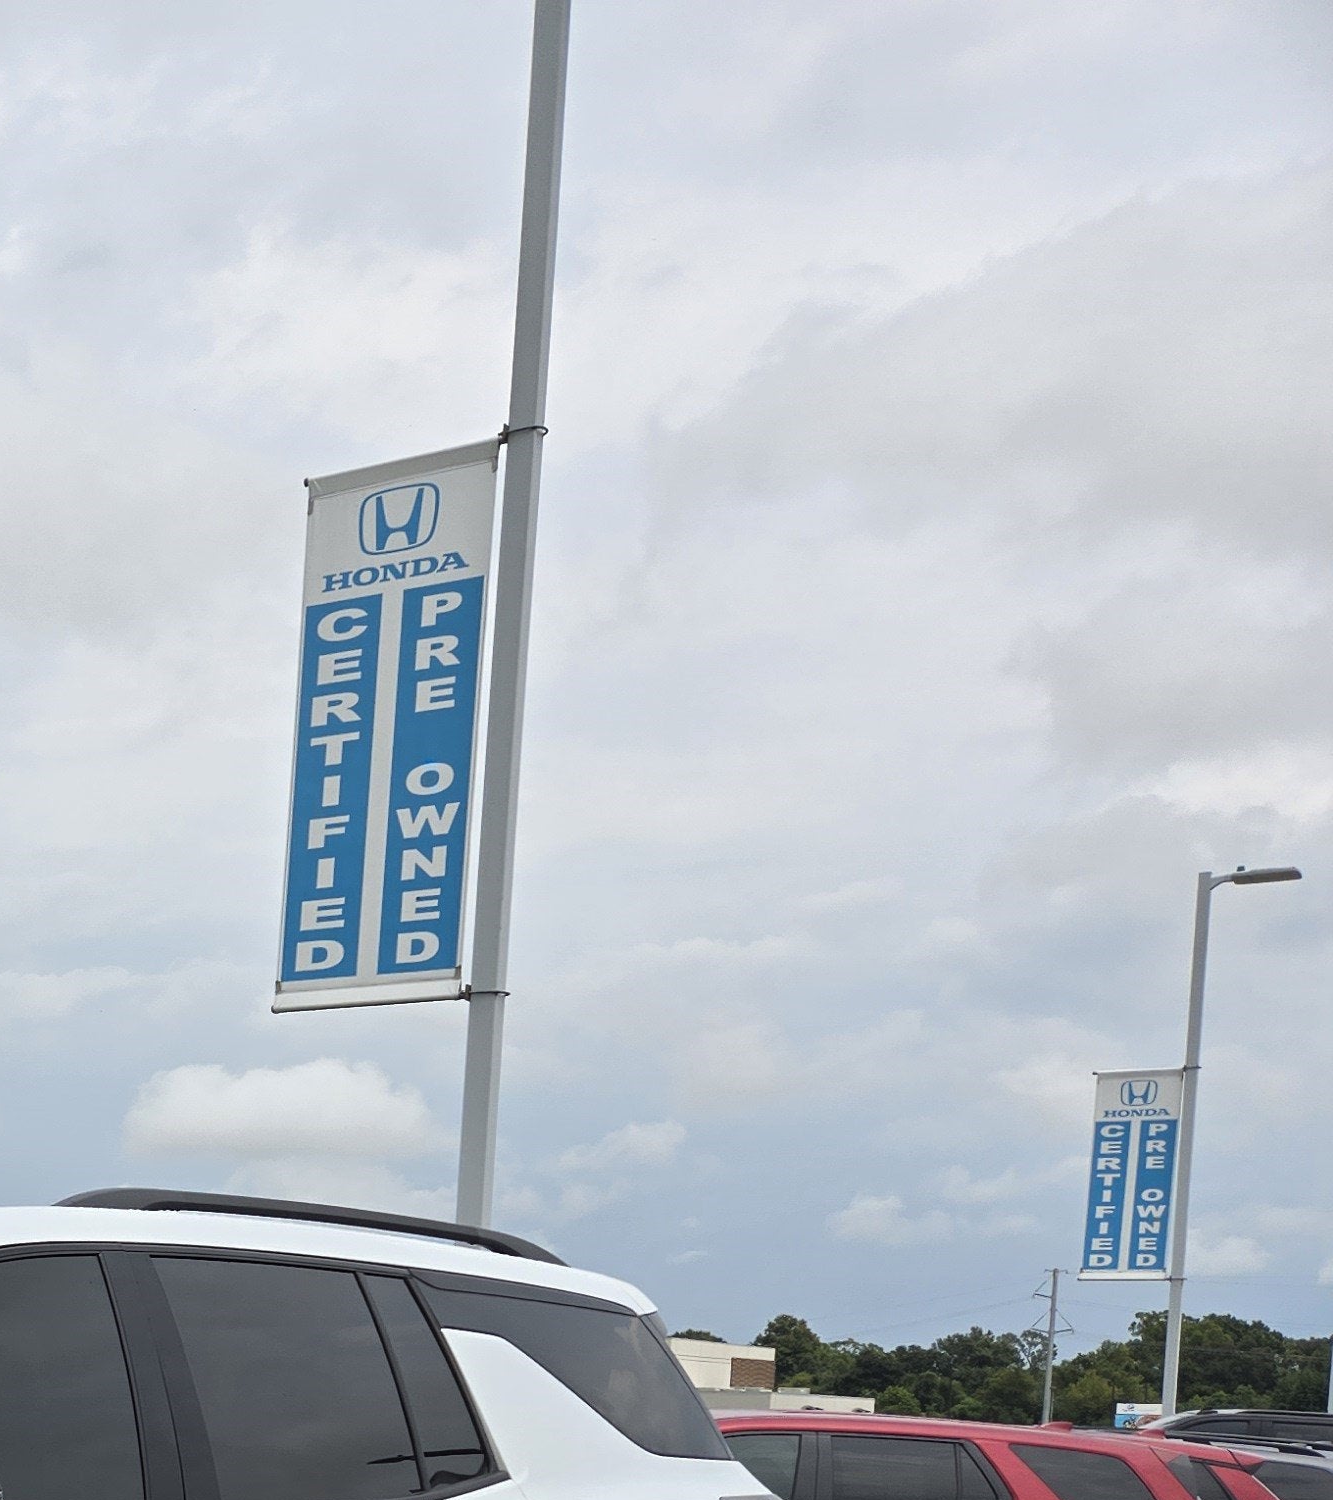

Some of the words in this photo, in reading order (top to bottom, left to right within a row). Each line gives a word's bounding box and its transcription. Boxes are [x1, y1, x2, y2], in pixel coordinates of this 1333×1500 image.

[321, 551, 470, 592] HONDA
[413, 590, 464, 713] PRE
[294, 607, 369, 973] CERTIFIED
[395, 761, 461, 966] OWNED
[1102, 1108, 1171, 1119] HONDA
[1145, 1123, 1169, 1170] PRE
[1088, 1124, 1126, 1267] CERTIFIED
[1136, 1188, 1167, 1267] OWNED
